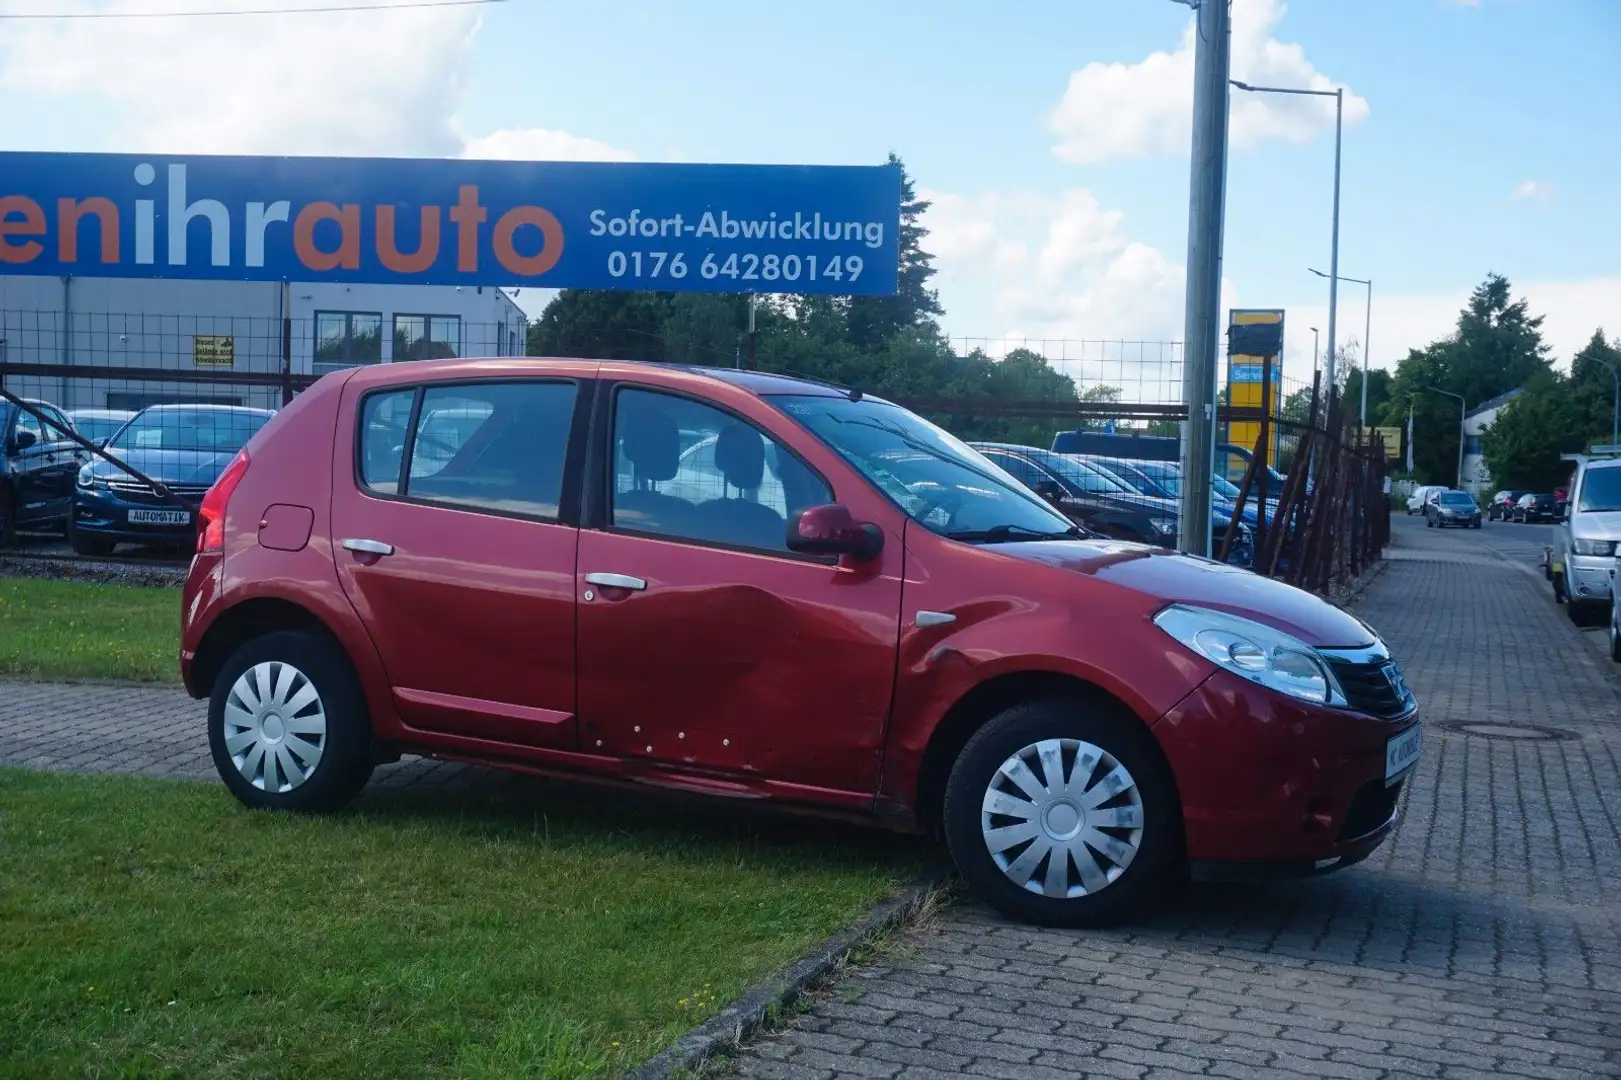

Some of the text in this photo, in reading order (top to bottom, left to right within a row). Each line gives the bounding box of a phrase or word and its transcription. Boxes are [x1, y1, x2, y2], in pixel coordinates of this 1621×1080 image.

[590, 209, 884, 248] Sofort-Abwicklung
[608, 251, 864, 282] 0176 64280149
[1234, 369, 1275, 381] Servi
[133, 511, 185, 522] AUTOMATIK
